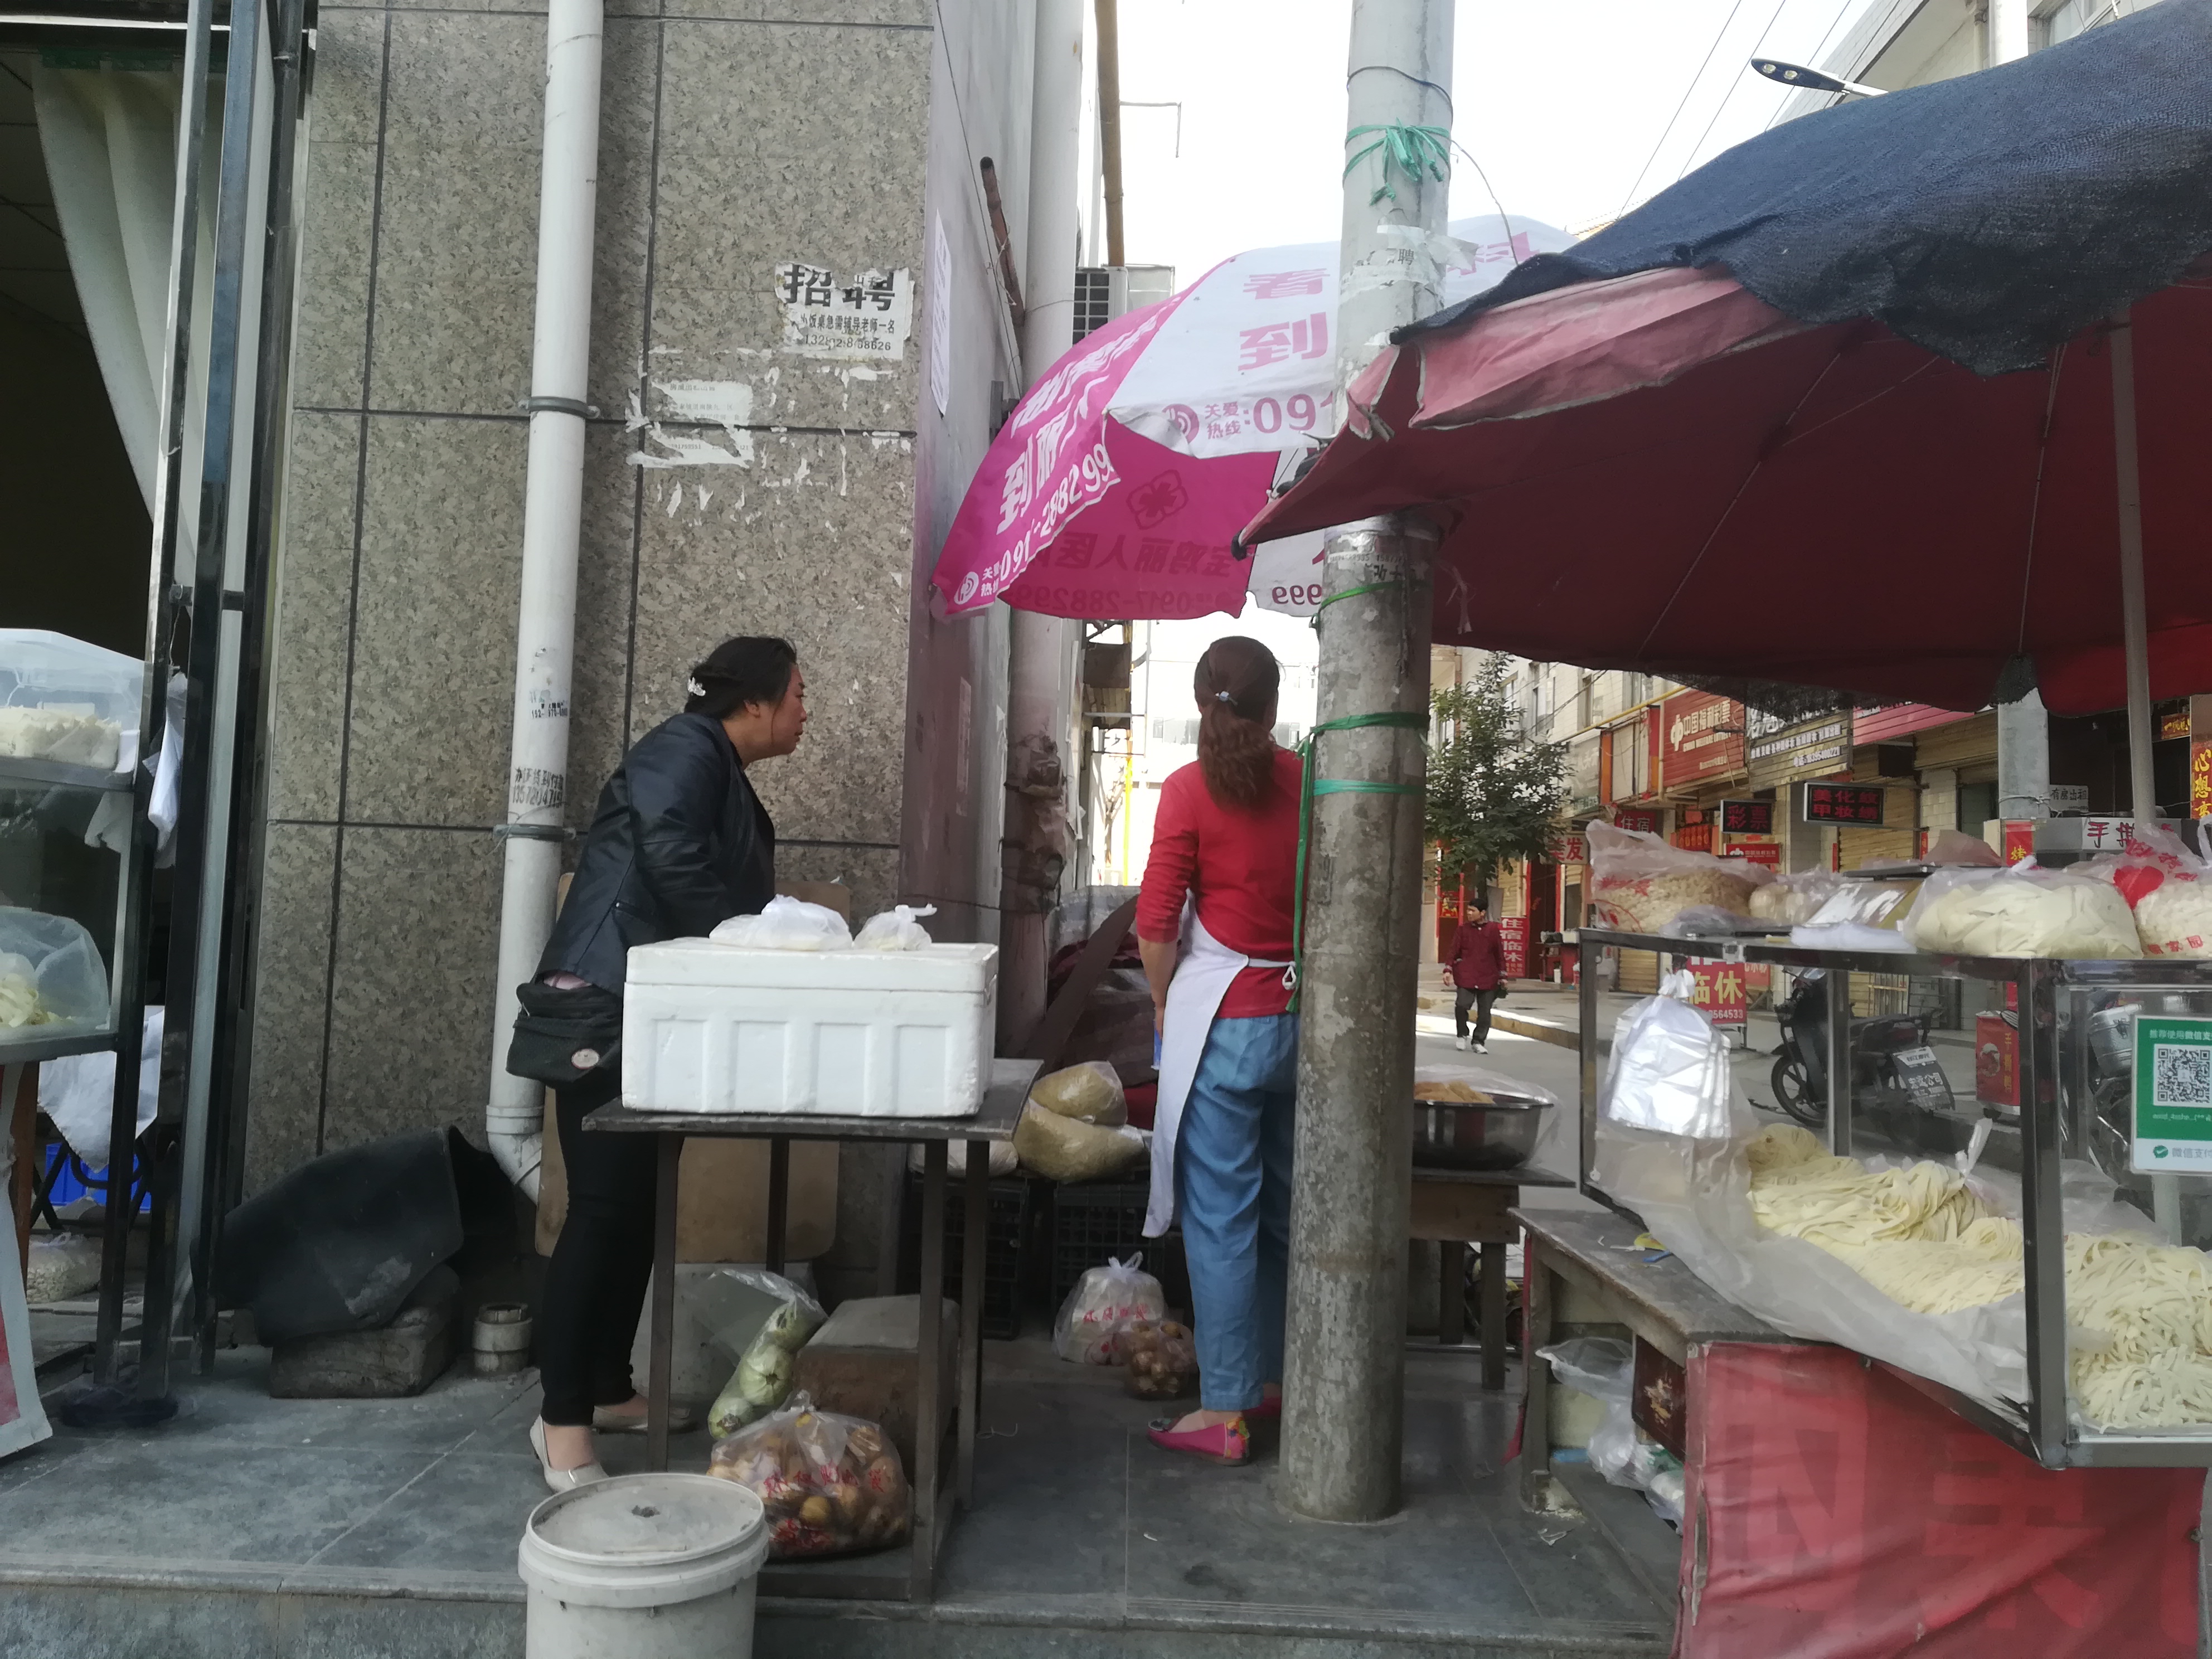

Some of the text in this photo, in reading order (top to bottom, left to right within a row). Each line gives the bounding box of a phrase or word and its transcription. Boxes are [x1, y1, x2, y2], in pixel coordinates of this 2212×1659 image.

[783, 264, 895, 311] 招聘
[1238, 312, 1329, 371] 到
[1204, 401, 1240, 419] 关爱
[1206, 420, 1241, 440] 热线
[2051, 788, 2088, 801] 有房出租
[1621, 815, 1651, 833] 住宿
[1727, 804, 1768, 830] 彩票
[2150, 1029, 2212, 1041] 推荐使用微信支
